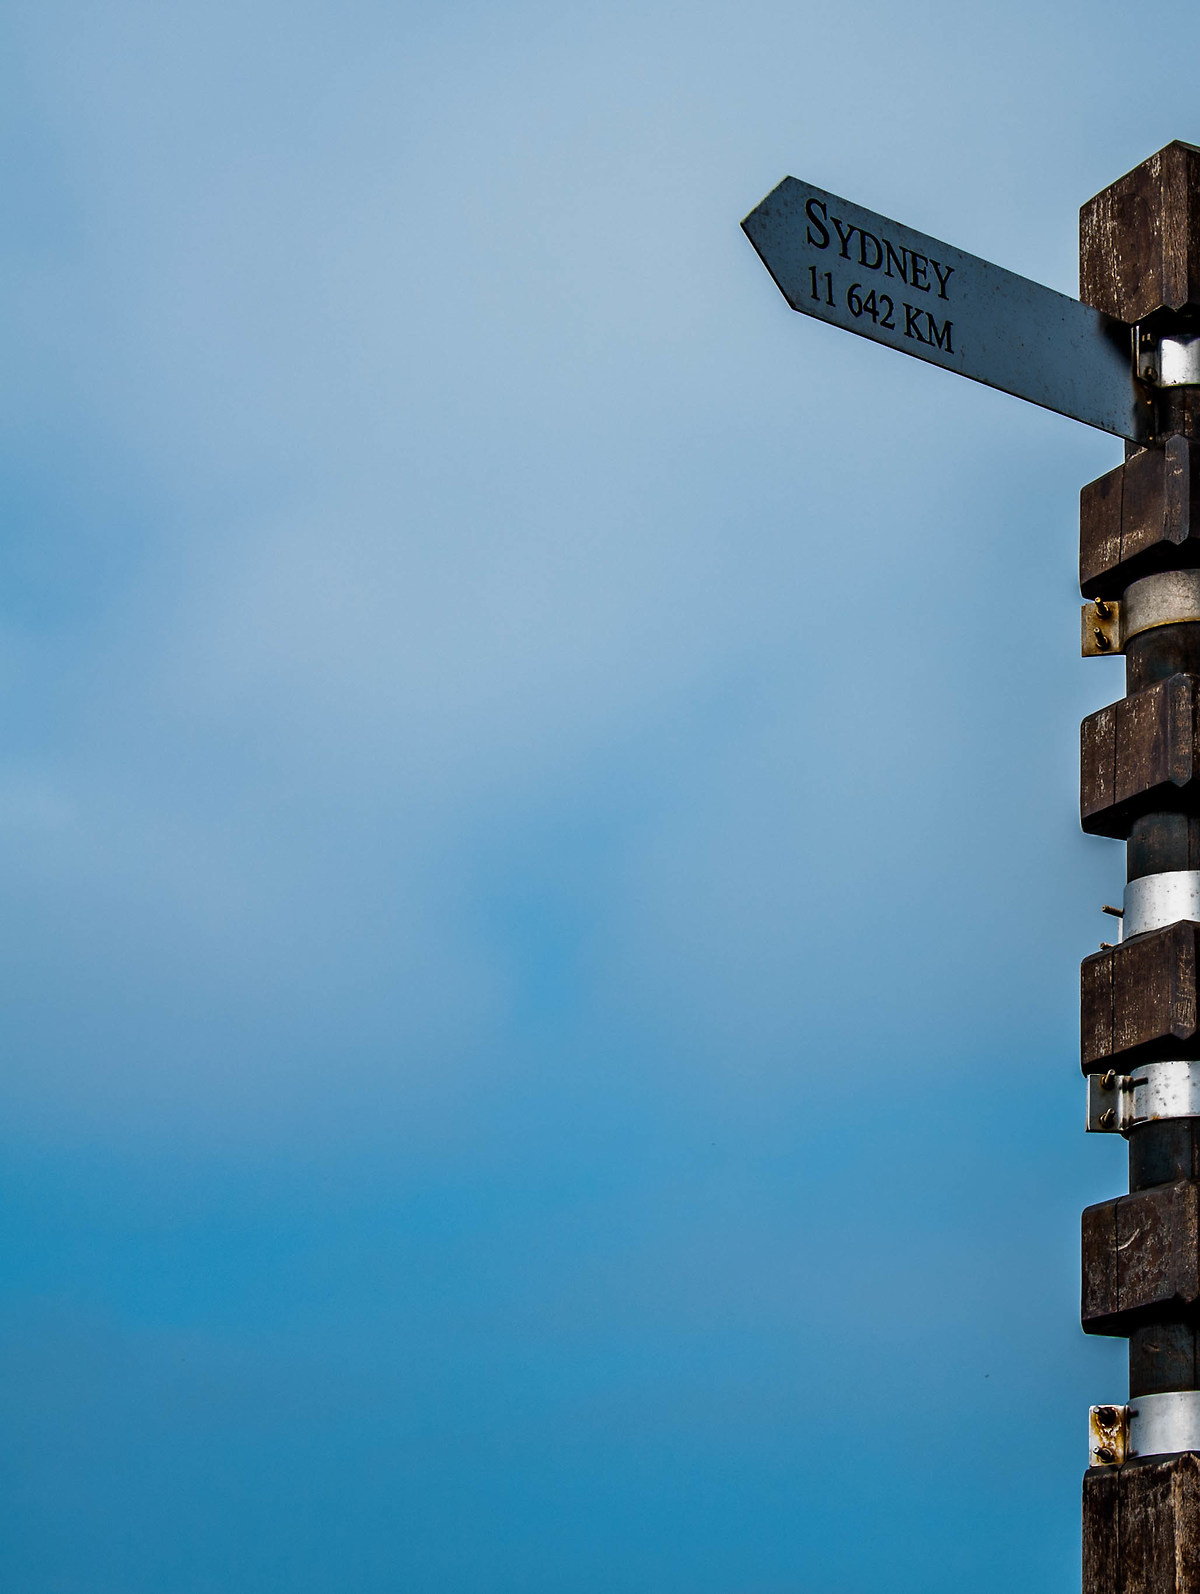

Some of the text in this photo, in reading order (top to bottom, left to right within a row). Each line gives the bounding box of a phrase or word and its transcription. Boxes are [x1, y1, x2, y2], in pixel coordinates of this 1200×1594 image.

[805, 198, 955, 300] SYDNEY
[808, 265, 955, 354] 11 642 KM
